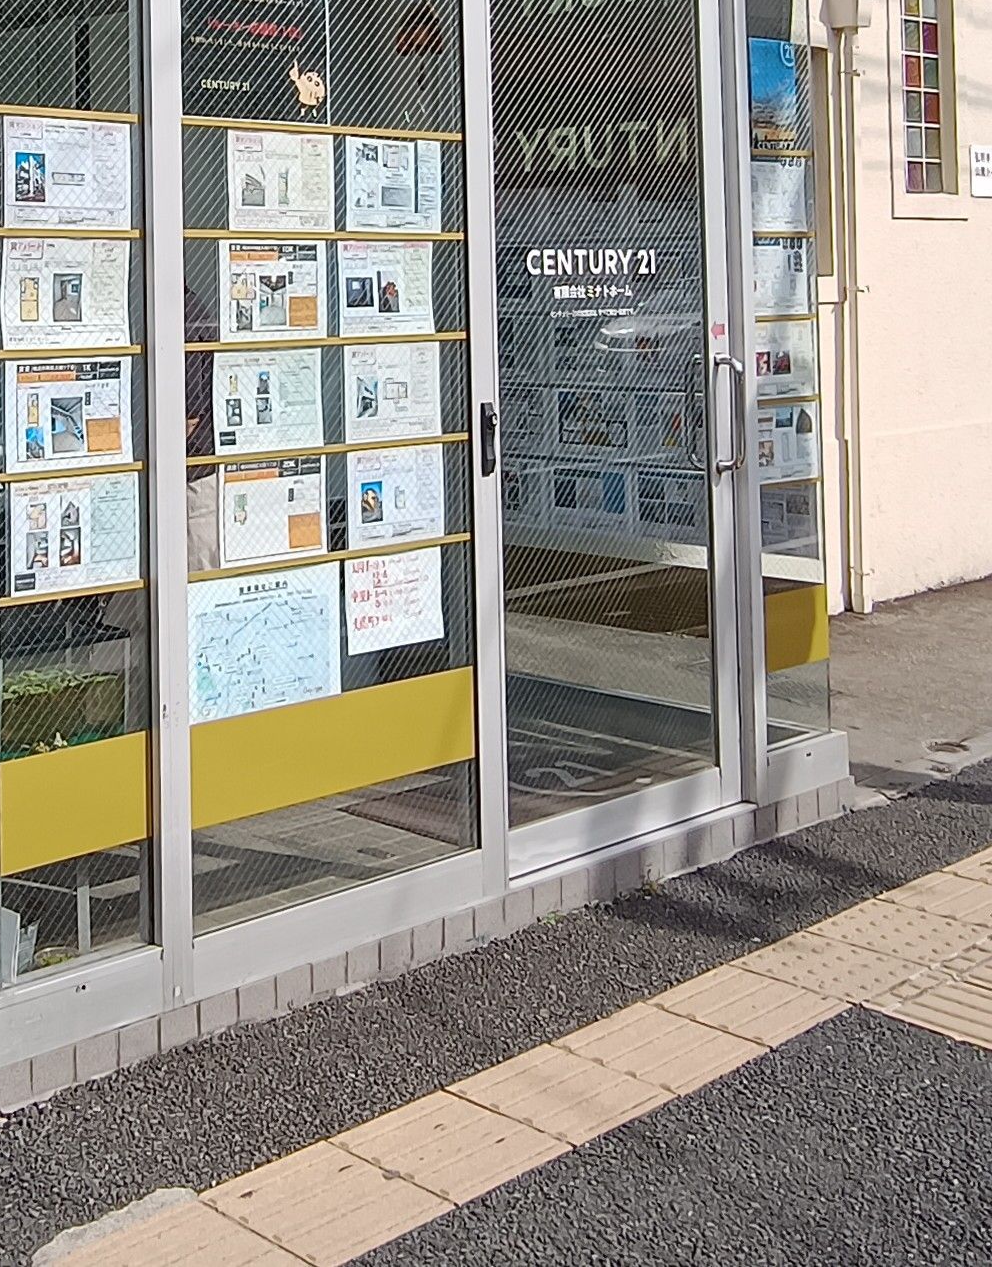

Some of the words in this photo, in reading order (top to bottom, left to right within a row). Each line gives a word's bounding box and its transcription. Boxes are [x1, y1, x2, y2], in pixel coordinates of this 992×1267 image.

[201, 79, 240, 91] CENTURY
[526, 249, 633, 276] CENTURY
[637, 248, 657, 275] 21
